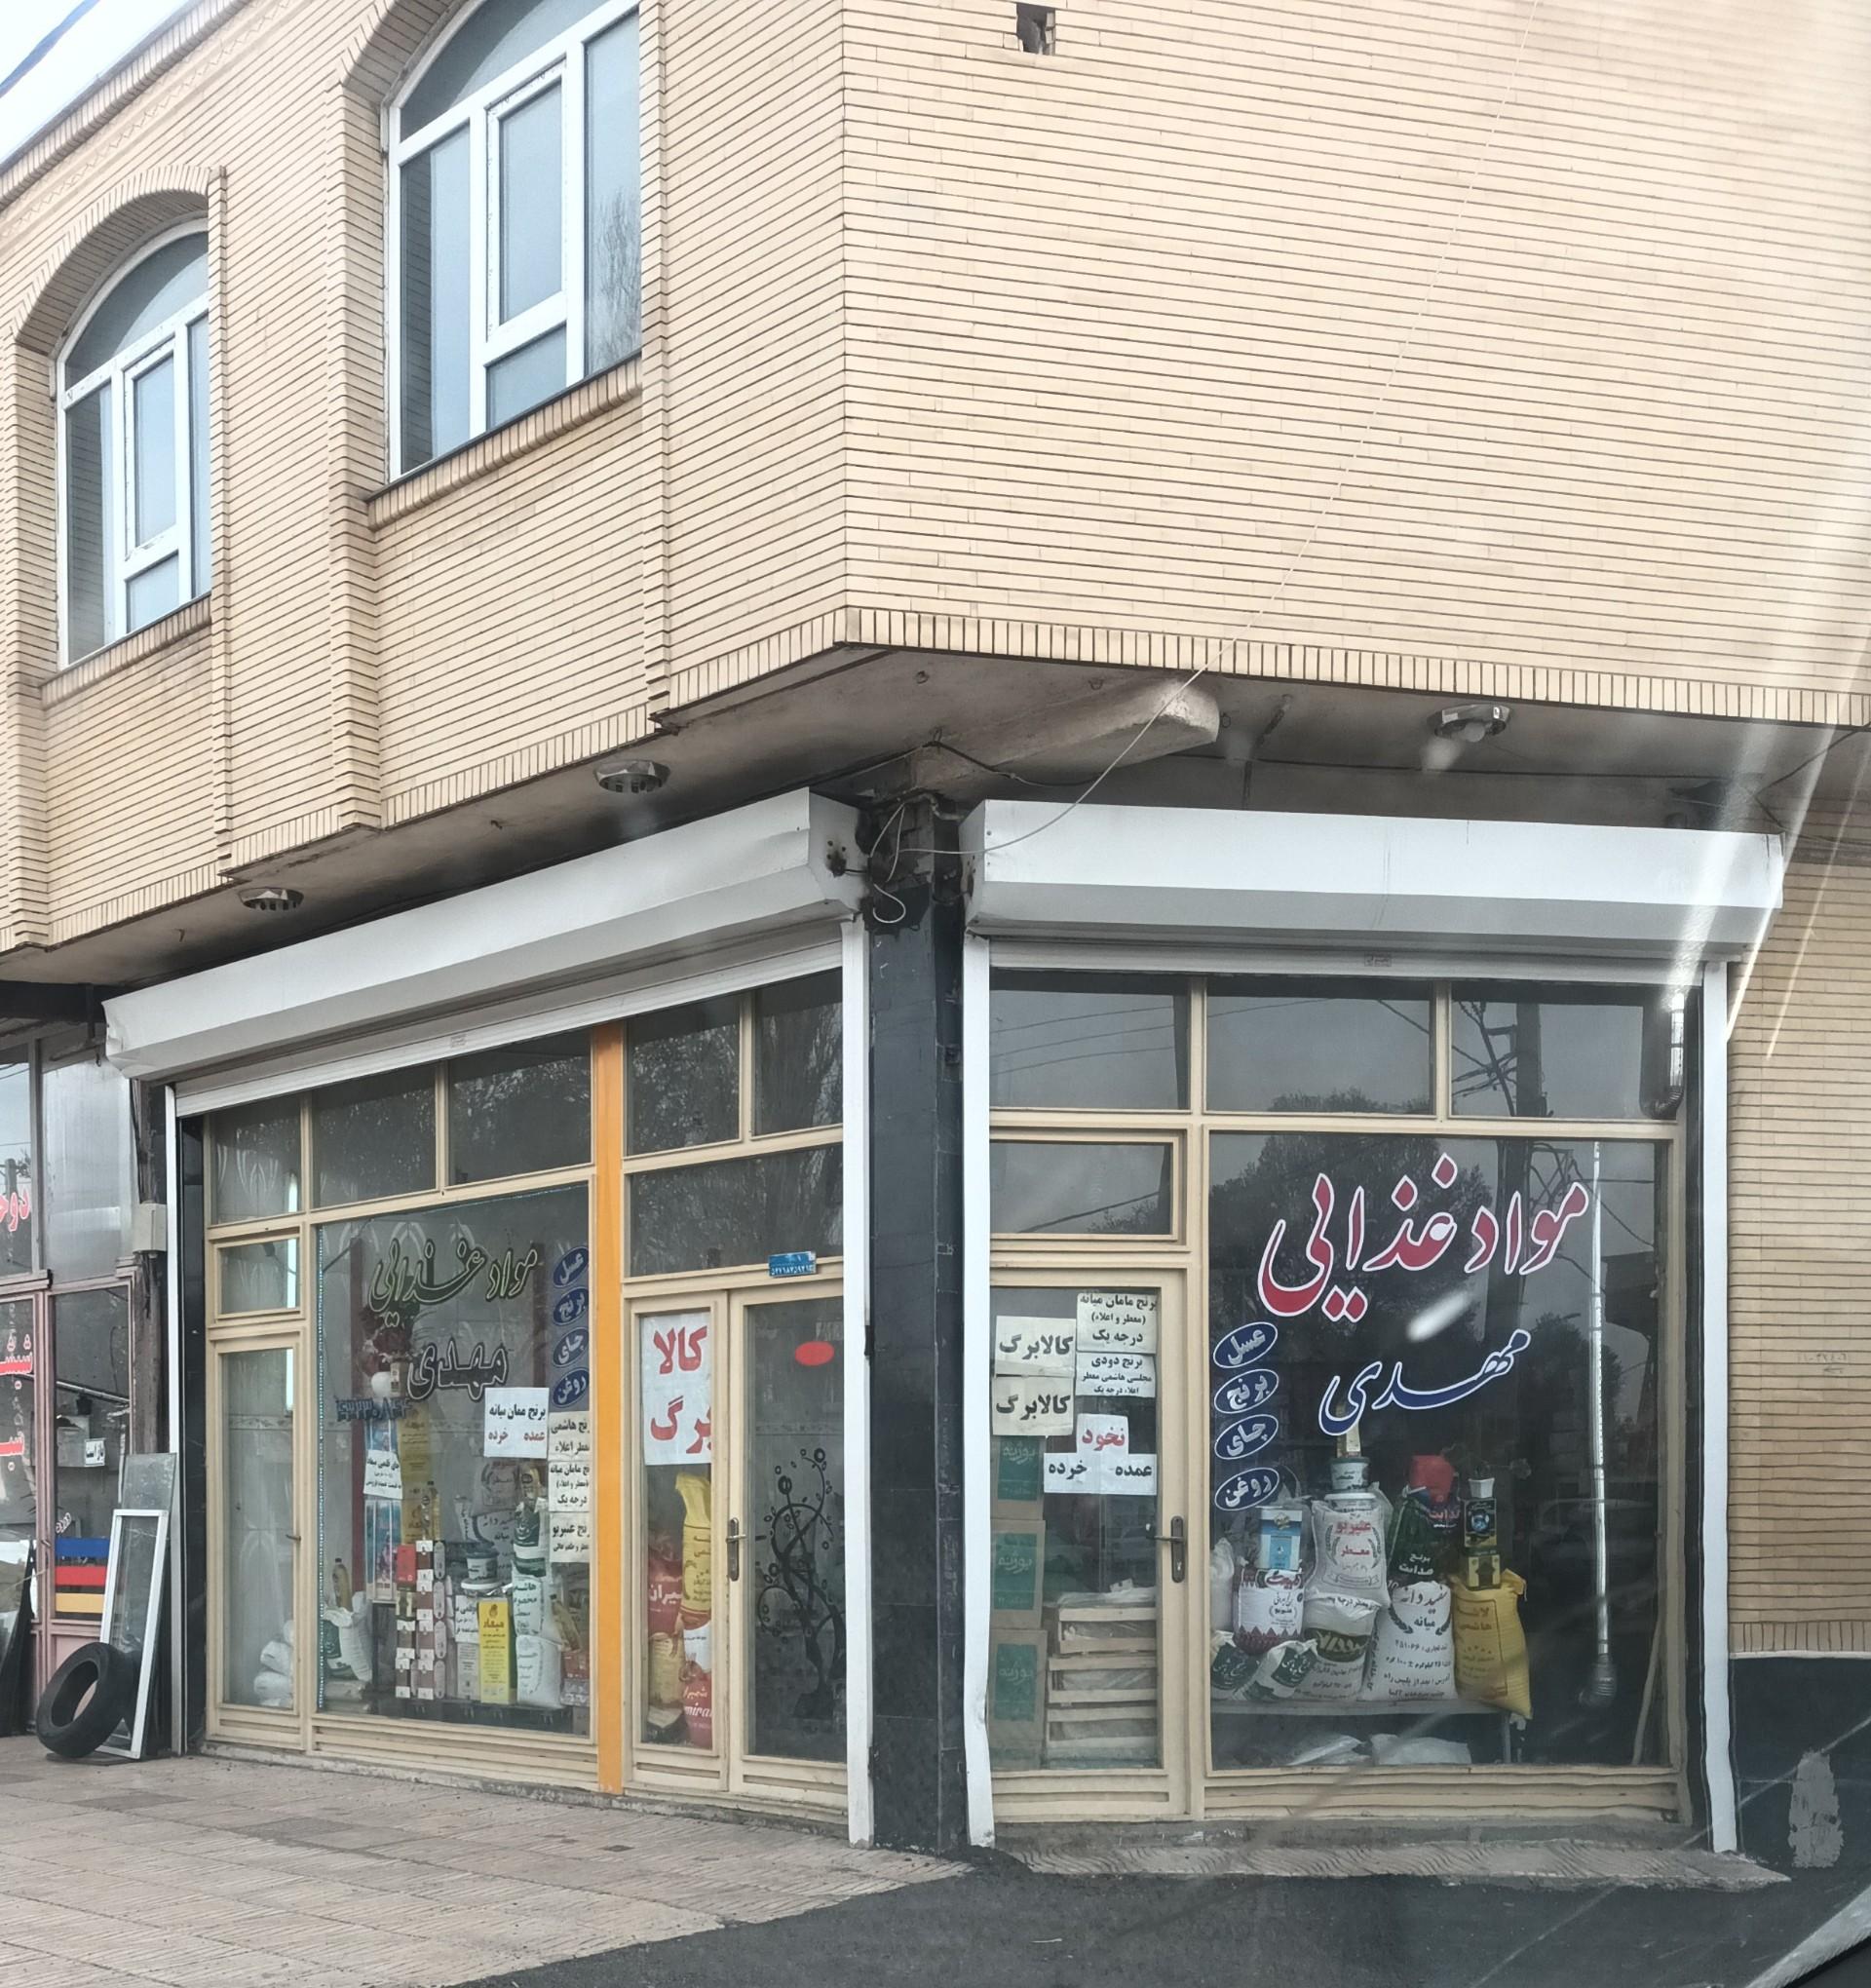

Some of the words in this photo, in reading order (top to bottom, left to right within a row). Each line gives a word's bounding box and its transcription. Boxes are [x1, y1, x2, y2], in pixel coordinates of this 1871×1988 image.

[1258, 1153, 1458, 1321] غذایی
[1465, 1182, 1589, 1275] مواد
[486, 1247, 538, 1301] مواد
[558, 1251, 585, 1284] عسل
[369, 1238, 485, 1327] غذایی
[558, 1291, 587, 1319] برنج
[1105, 1294, 1133, 1308] مامان
[557, 1332, 585, 1364] چای
[653, 1325, 708, 1375] کالا
[999, 1333, 1074, 1360] کالابرگ
[1092, 1329, 1111, 1345] یک
[1114, 1332, 1144, 1346] درجه
[1227, 1328, 1266, 1365] عسل
[407, 1339, 509, 1401] مهدی
[1091, 1356, 1120, 1369] دودی
[1122, 1356, 1143, 1369] برنج
[557, 1376, 588, 1403] روغن
[1226, 1375, 1270, 1410] برنج
[1318, 1328, 1531, 1435] مهدی
[527, 1403, 547, 1421] برنج
[995, 1394, 1071, 1421] کالابرگ
[551, 1418, 577, 1434] هاشمی
[1082, 1427, 1126, 1451] نخود
[1226, 1423, 1269, 1458] چای
[1049, 1459, 1088, 1480] خرده
[1115, 1464, 1153, 1477] عمده
[557, 1494, 569, 1507] یک
[569, 1496, 588, 1508] درجه
[1225, 1475, 1273, 1508] روغن
[1413, 1616, 1436, 1630] میانه
